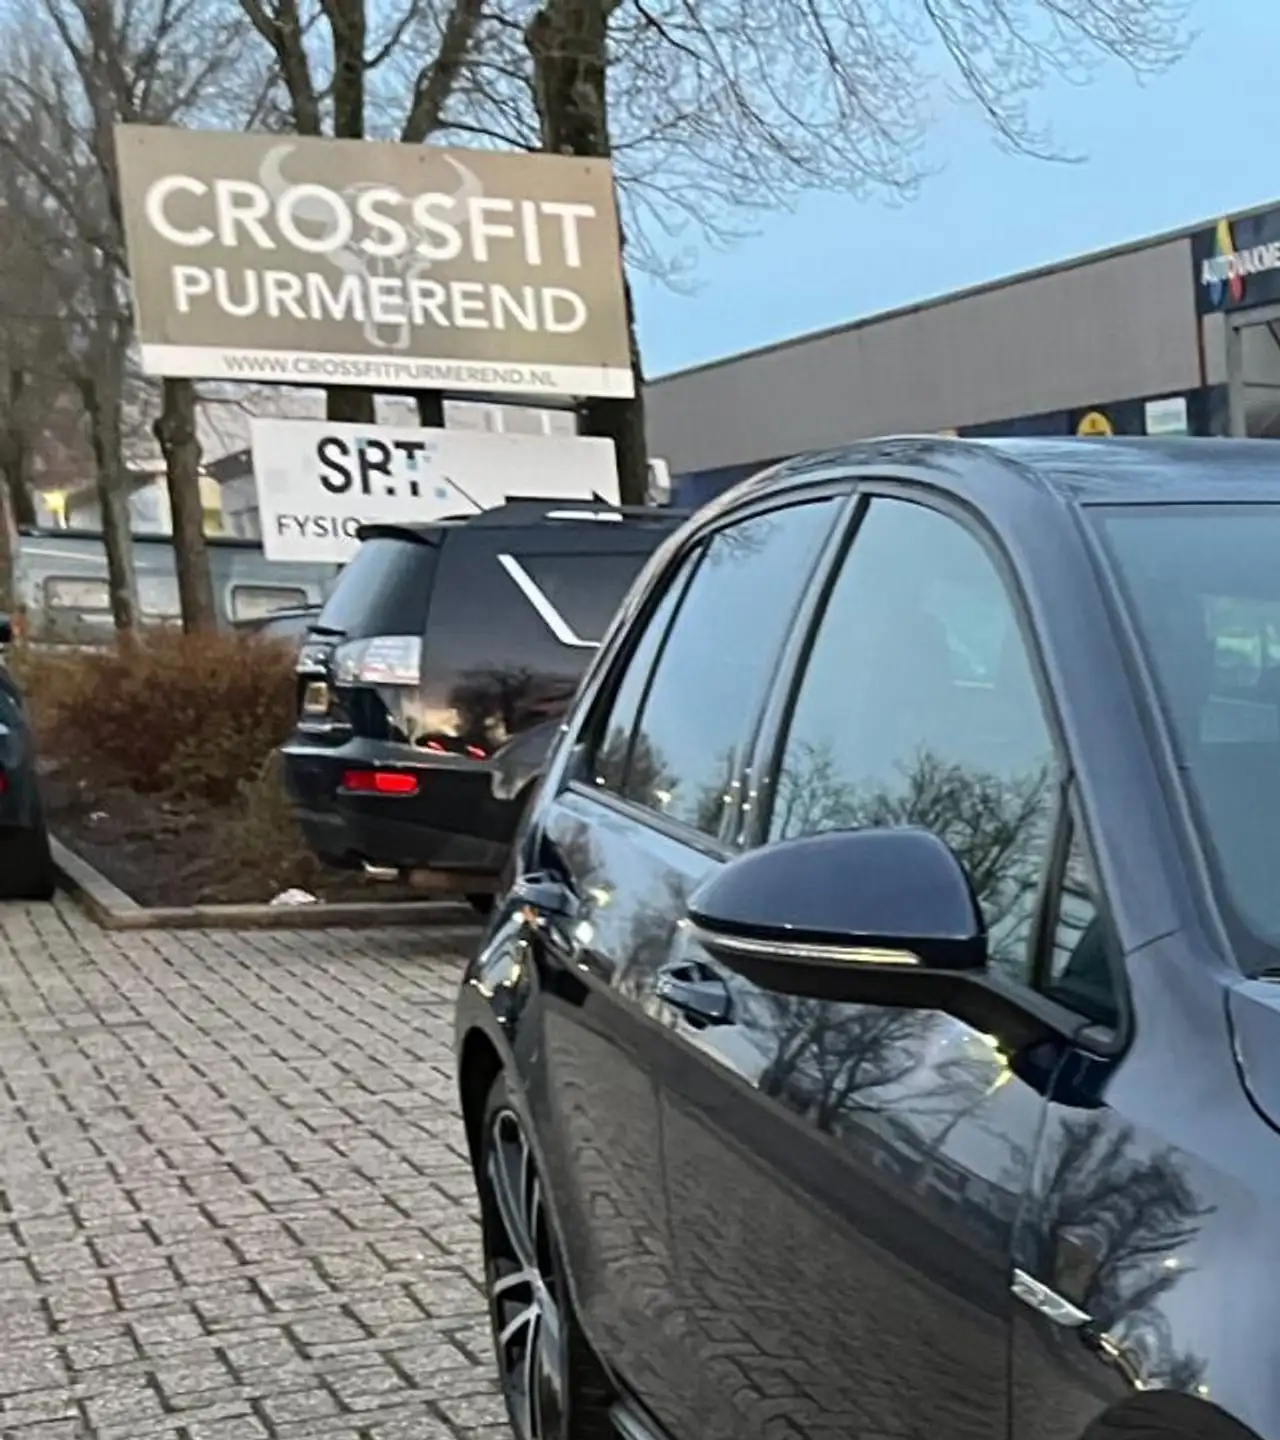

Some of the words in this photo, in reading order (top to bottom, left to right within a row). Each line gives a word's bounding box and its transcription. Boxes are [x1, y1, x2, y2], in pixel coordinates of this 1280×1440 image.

[143, 173, 596, 269] CROSSFIT
[171, 265, 588, 334] PURMEREND
[223, 355, 557, 387] WWW.CROSSFITPURMEREND.NL
